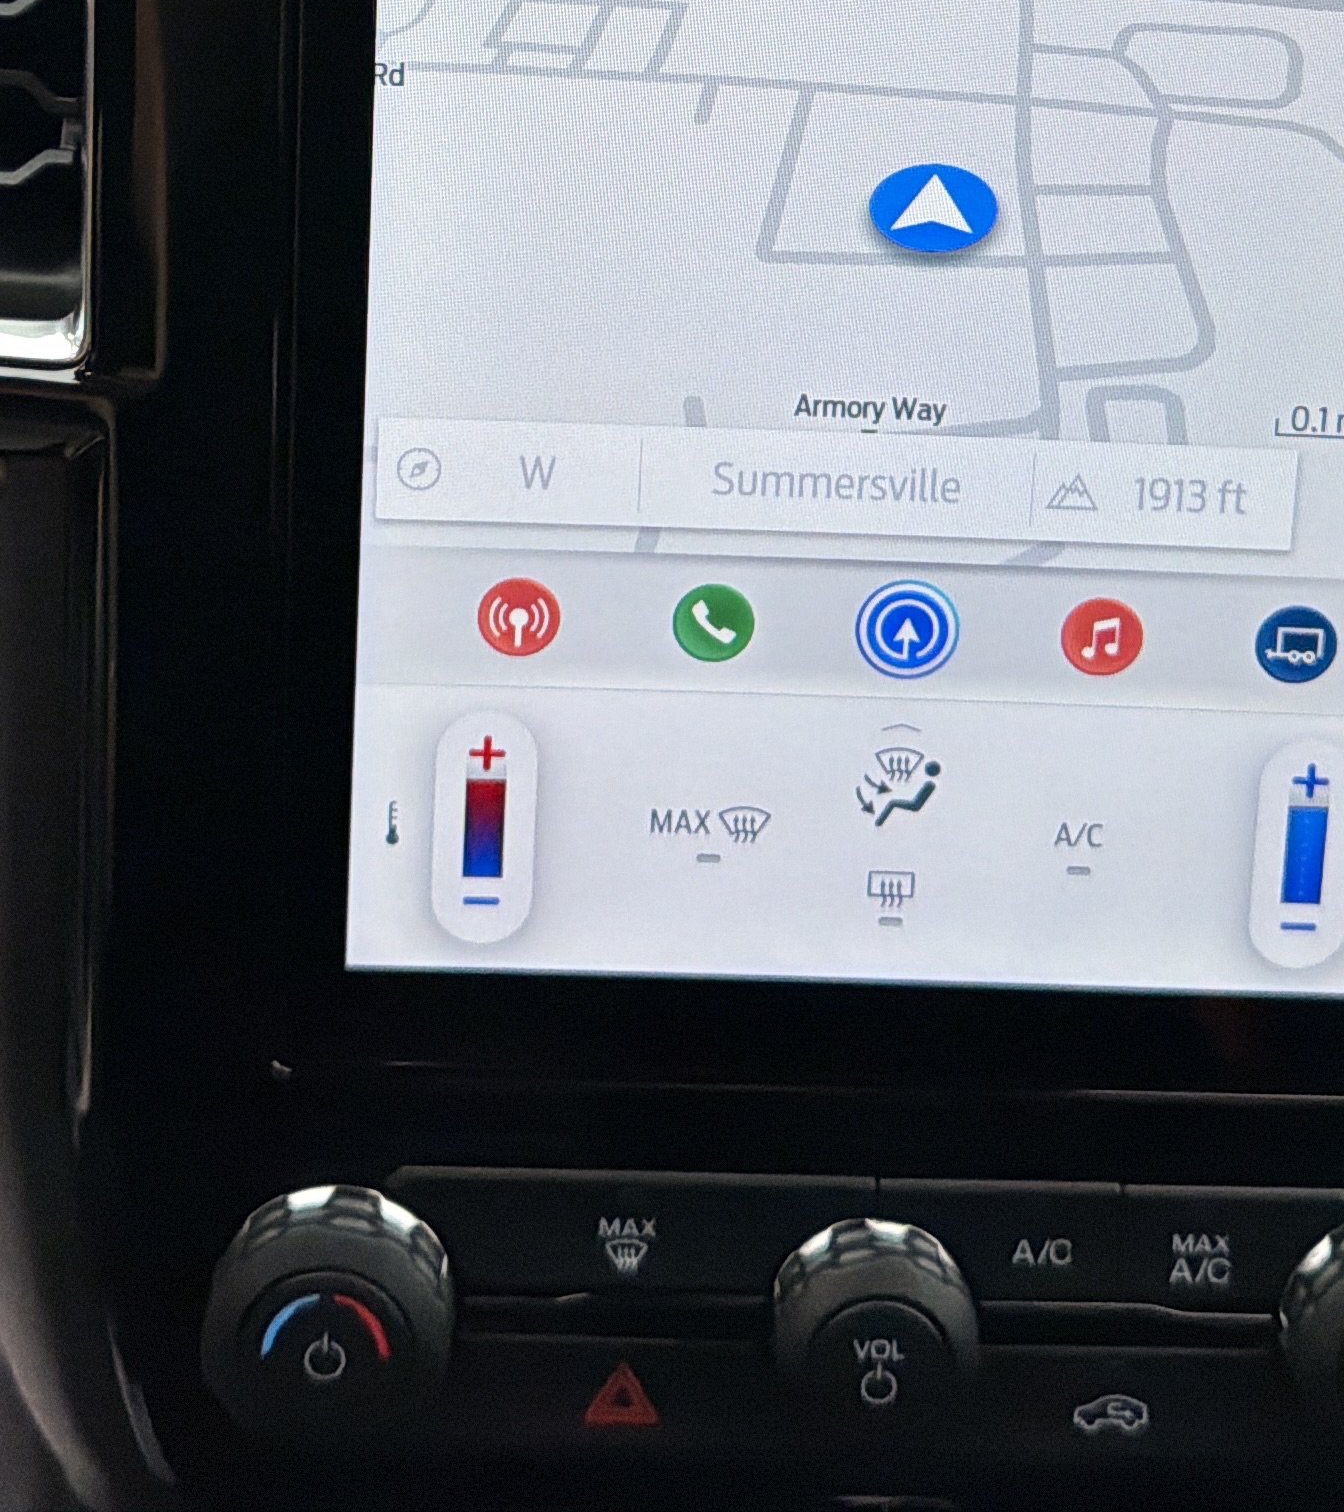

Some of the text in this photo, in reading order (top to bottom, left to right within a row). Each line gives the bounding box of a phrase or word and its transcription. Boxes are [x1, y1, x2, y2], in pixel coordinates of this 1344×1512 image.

[375, 61, 405, 87] Rd
[794, 393, 947, 427] Armory Way
[1291, 405, 1328, 433] 0.1
[519, 455, 557, 491] W
[712, 461, 961, 504] Summersville
[1135, 477, 1247, 516] 1913 ft
[650, 808, 710, 835] MAX
[1054, 822, 1103, 849] A/C
[597, 1216, 657, 1240] MAX
[1012, 1238, 1072, 1266] A/C
[1172, 1233, 1230, 1254] MAX
[1169, 1257, 1231, 1285] A/C
[853, 1338, 905, 1362] VOL
